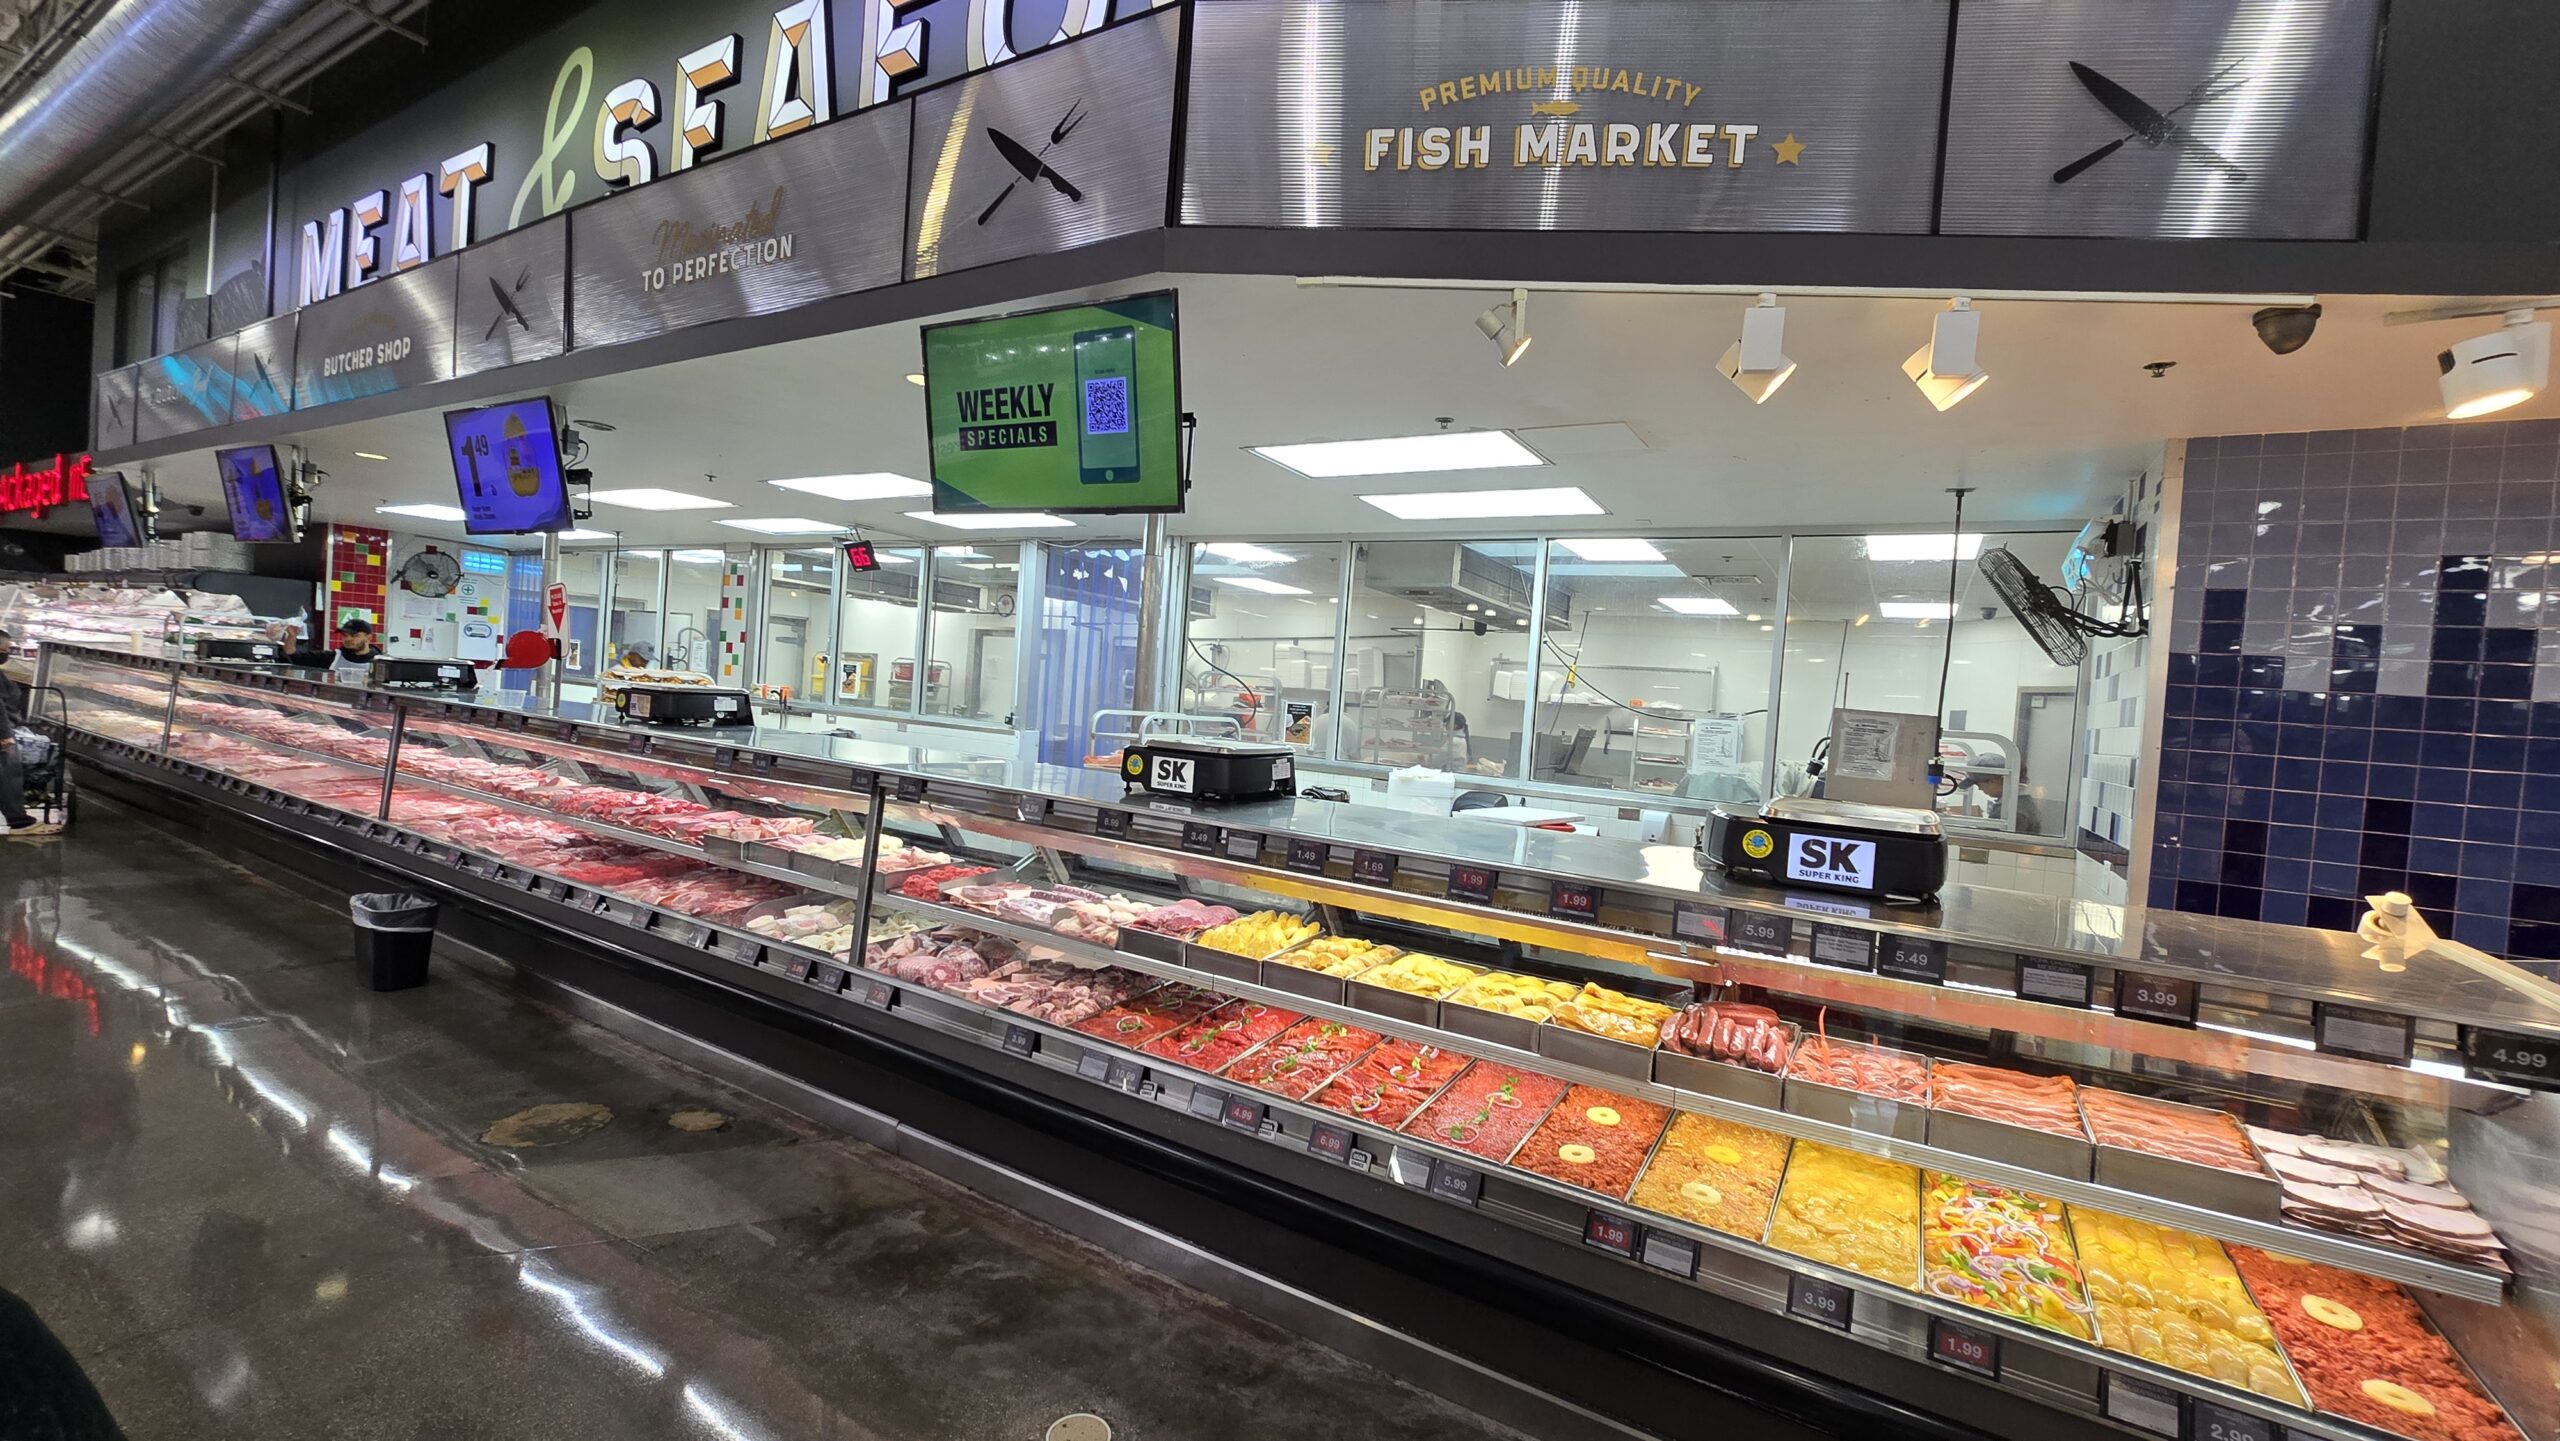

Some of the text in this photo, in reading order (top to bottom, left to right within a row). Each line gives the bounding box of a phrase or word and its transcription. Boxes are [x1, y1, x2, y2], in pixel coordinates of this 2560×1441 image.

[1418, 66, 1702, 112] PREMIUM QUALITY
[1364, 122, 1760, 171] FISH MARKET
[299, 142, 495, 305] MEAT
[642, 233, 793, 292] TO PERFECTION
[323, 337, 411, 377] BUTCHER SHOP
[956, 382, 1055, 423] WEEKLY
[966, 426, 1048, 447] SPECIALS
[1157, 759, 1188, 783] SK
[1156, 781, 1173, 789] SUPER
[1297, 850, 1316, 861] 1.49
[1799, 838, 1861, 875] SK
[1363, 861, 1384, 872] 1.69
[1463, 873, 1483, 886] 1.99
[1798, 869, 1859, 884] SUPER KING
[1563, 893, 1587, 906] 1.99
[1745, 924, 1775, 939] 5.99
[1895, 951, 1928, 966] 5.49
[2137, 989, 2177, 1006] 3.99
[2492, 1048, 2547, 1068] 4.99
[1233, 1107, 1253, 1120] 4.99
[1320, 1135, 1340, 1150] 6.99
[1444, 1175, 1467, 1191] 5.99
[1597, 1225, 1624, 1243] 1.99
[1804, 1292, 1836, 1312] 3.99
[1947, 1337, 1982, 1359] 1.99
